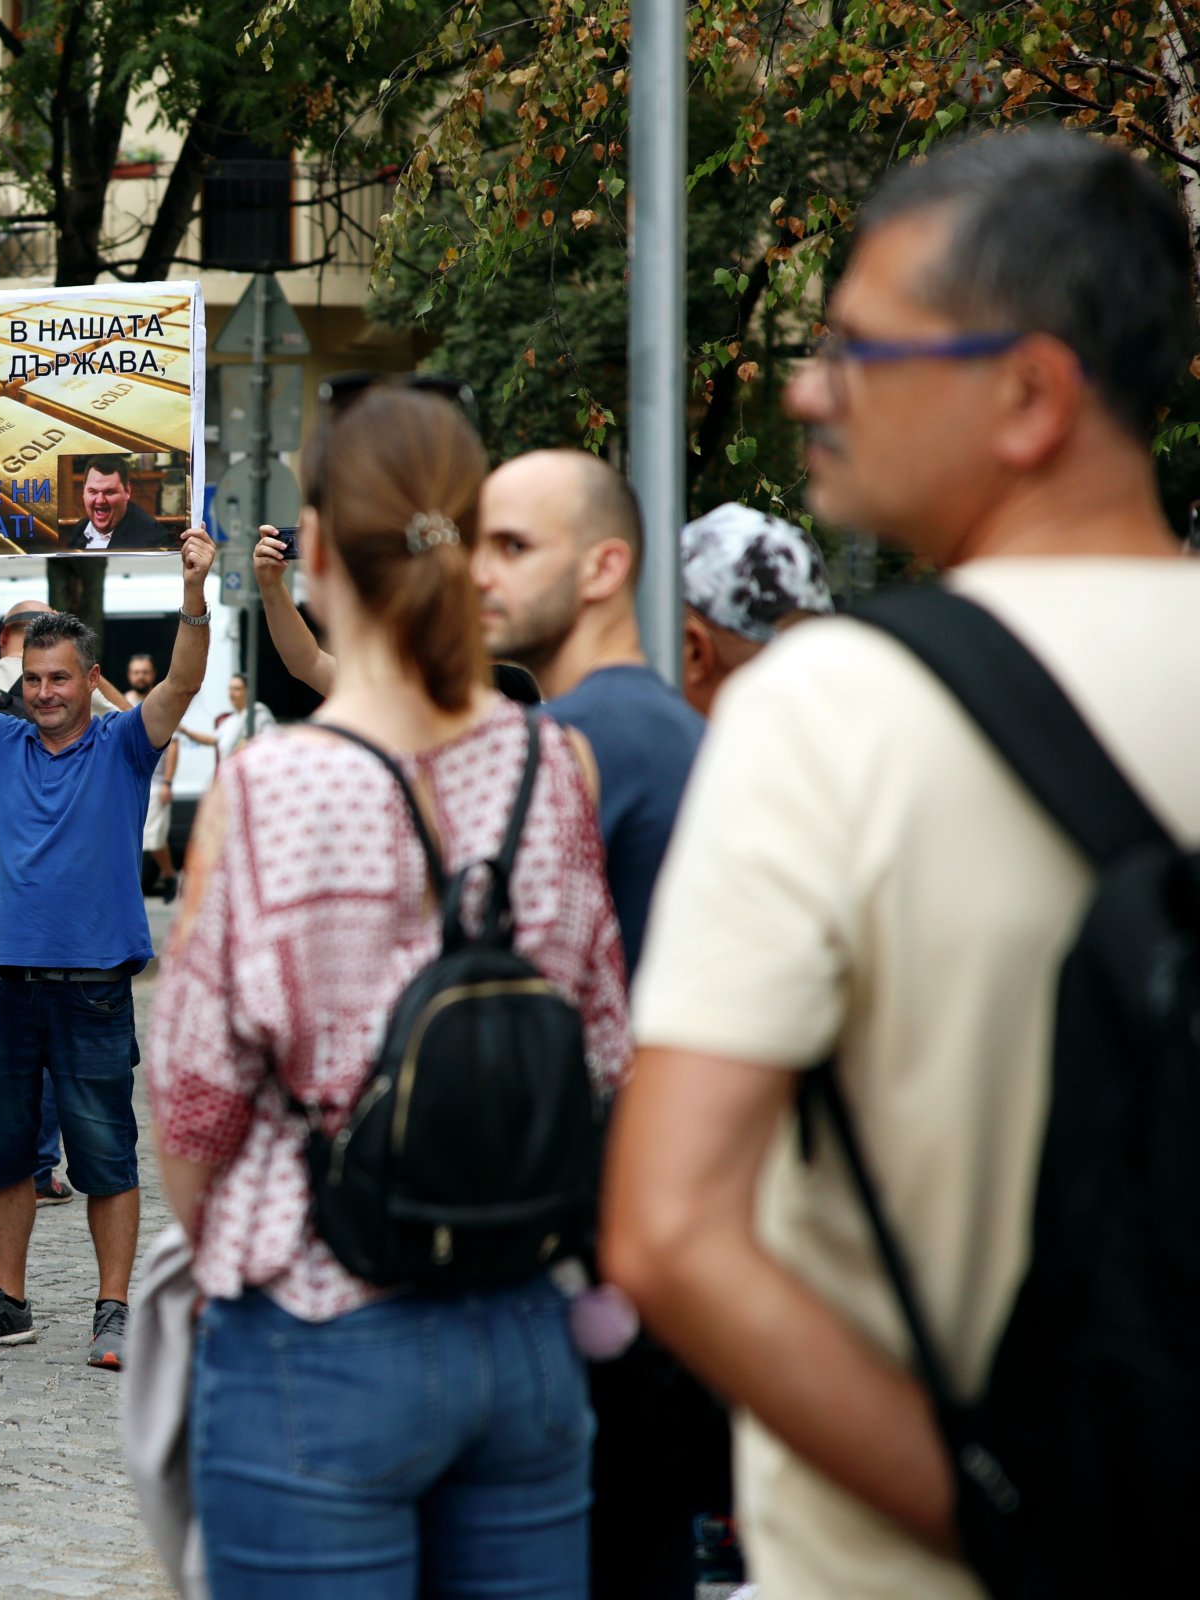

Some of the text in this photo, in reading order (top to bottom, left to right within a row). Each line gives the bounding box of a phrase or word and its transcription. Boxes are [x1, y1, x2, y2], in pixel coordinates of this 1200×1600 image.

[10, 314, 164, 343] В НАШАТА
[8, 349, 166, 383] ДЪРЖАВА,
[90, 383, 134, 411] GOLD
[1, 428, 66, 474] GOLD
[11, 478, 51, 504] НИ
